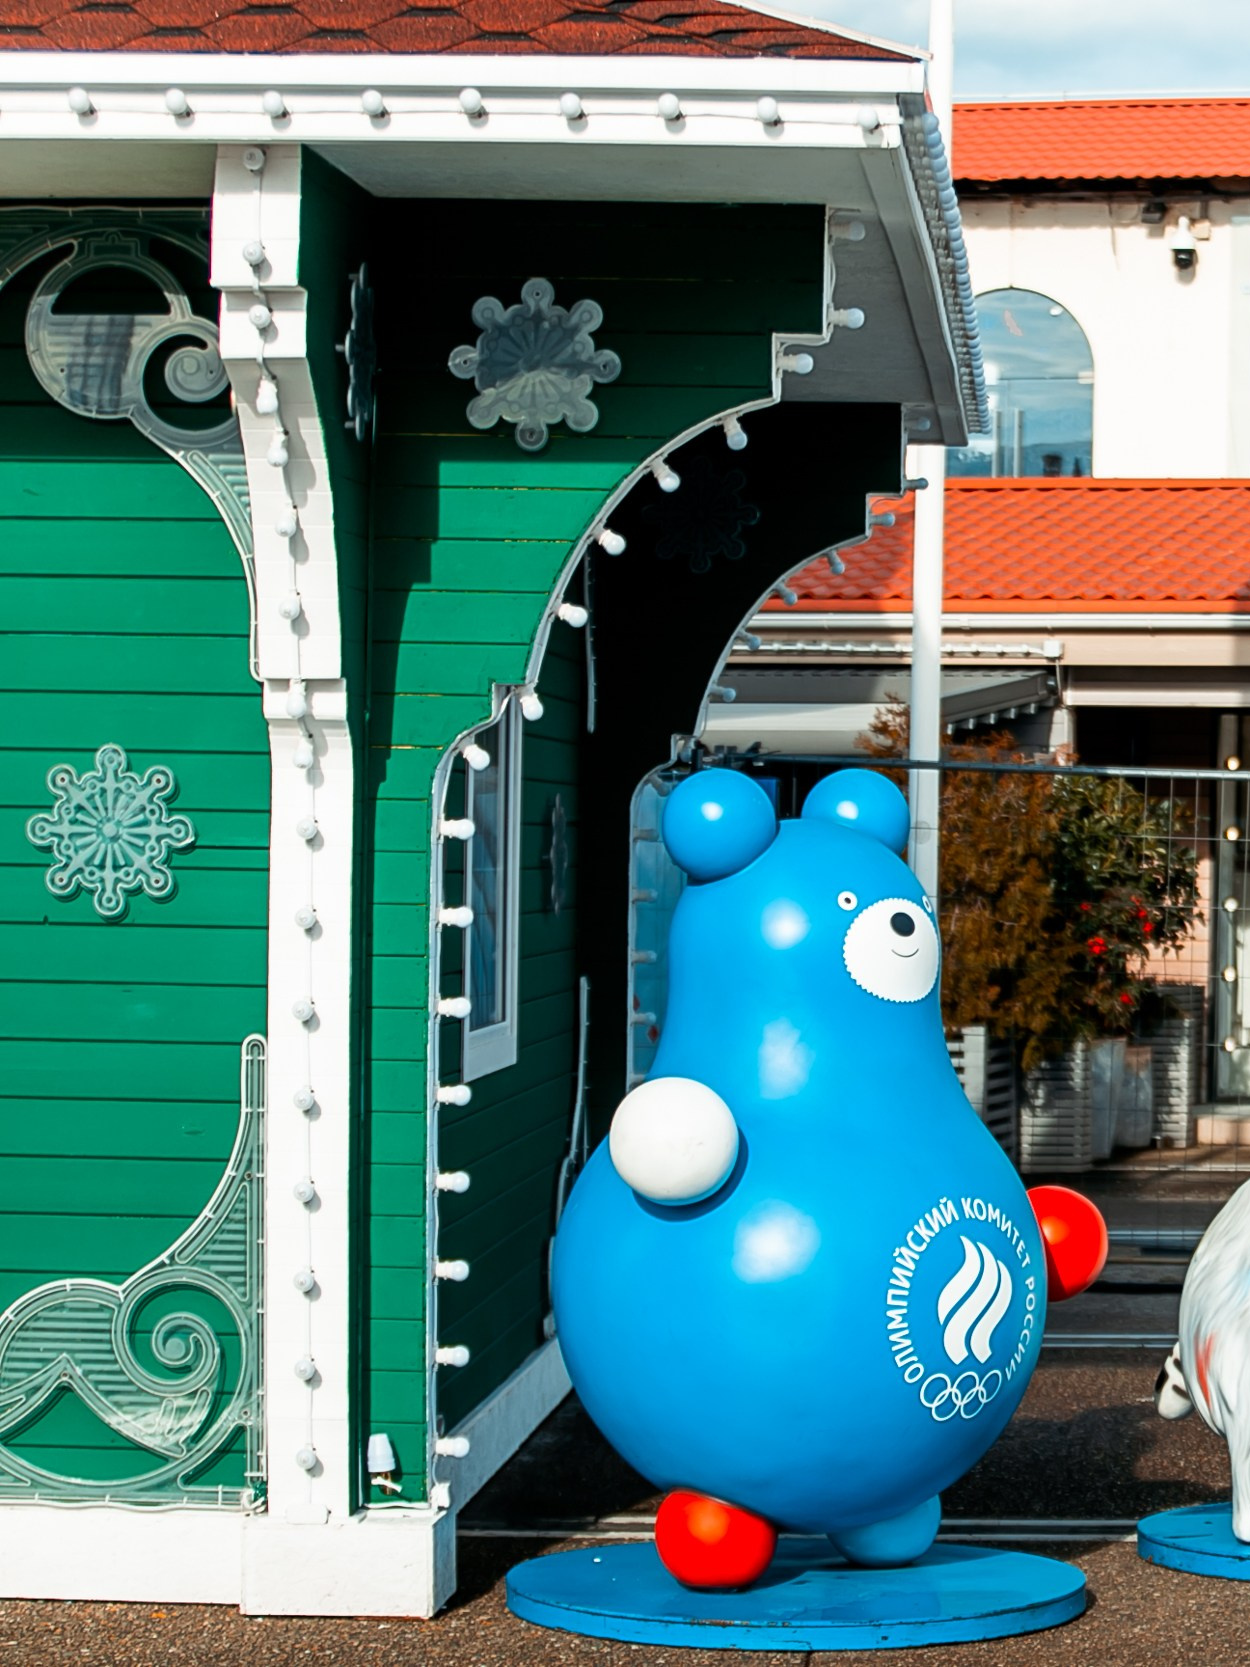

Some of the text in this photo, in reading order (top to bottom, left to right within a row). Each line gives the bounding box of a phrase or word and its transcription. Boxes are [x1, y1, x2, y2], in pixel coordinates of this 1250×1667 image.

[886, 1197, 1036, 1384] ОЛИМПИЙСКИЙ КОМИТЕТ РОССИИ
